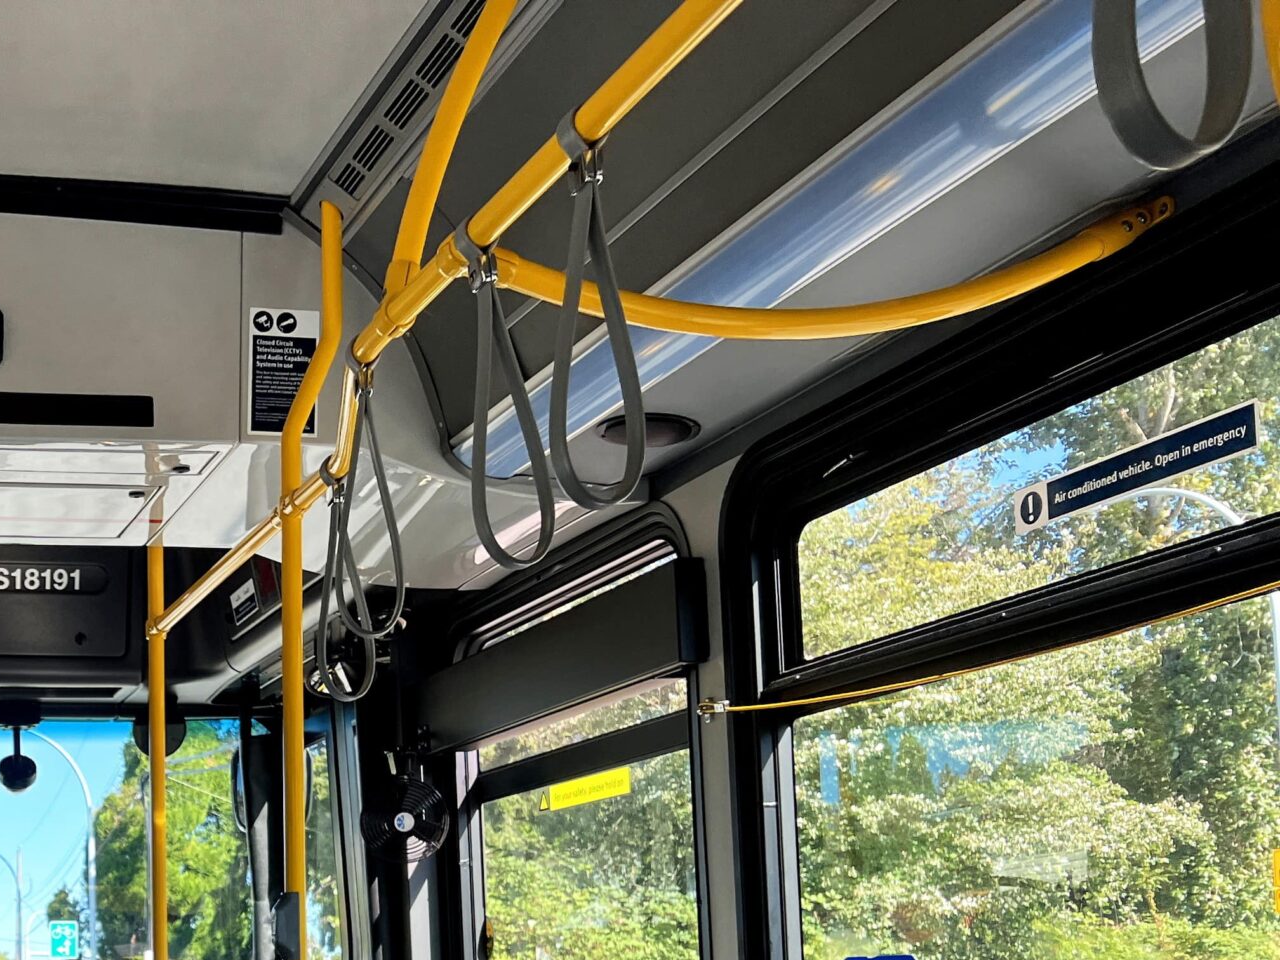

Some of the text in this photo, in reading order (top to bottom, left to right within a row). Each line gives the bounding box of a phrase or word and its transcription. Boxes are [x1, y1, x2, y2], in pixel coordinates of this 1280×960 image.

[1054, 425, 1247, 504] Air conditioned vehicle. Open in emergency
